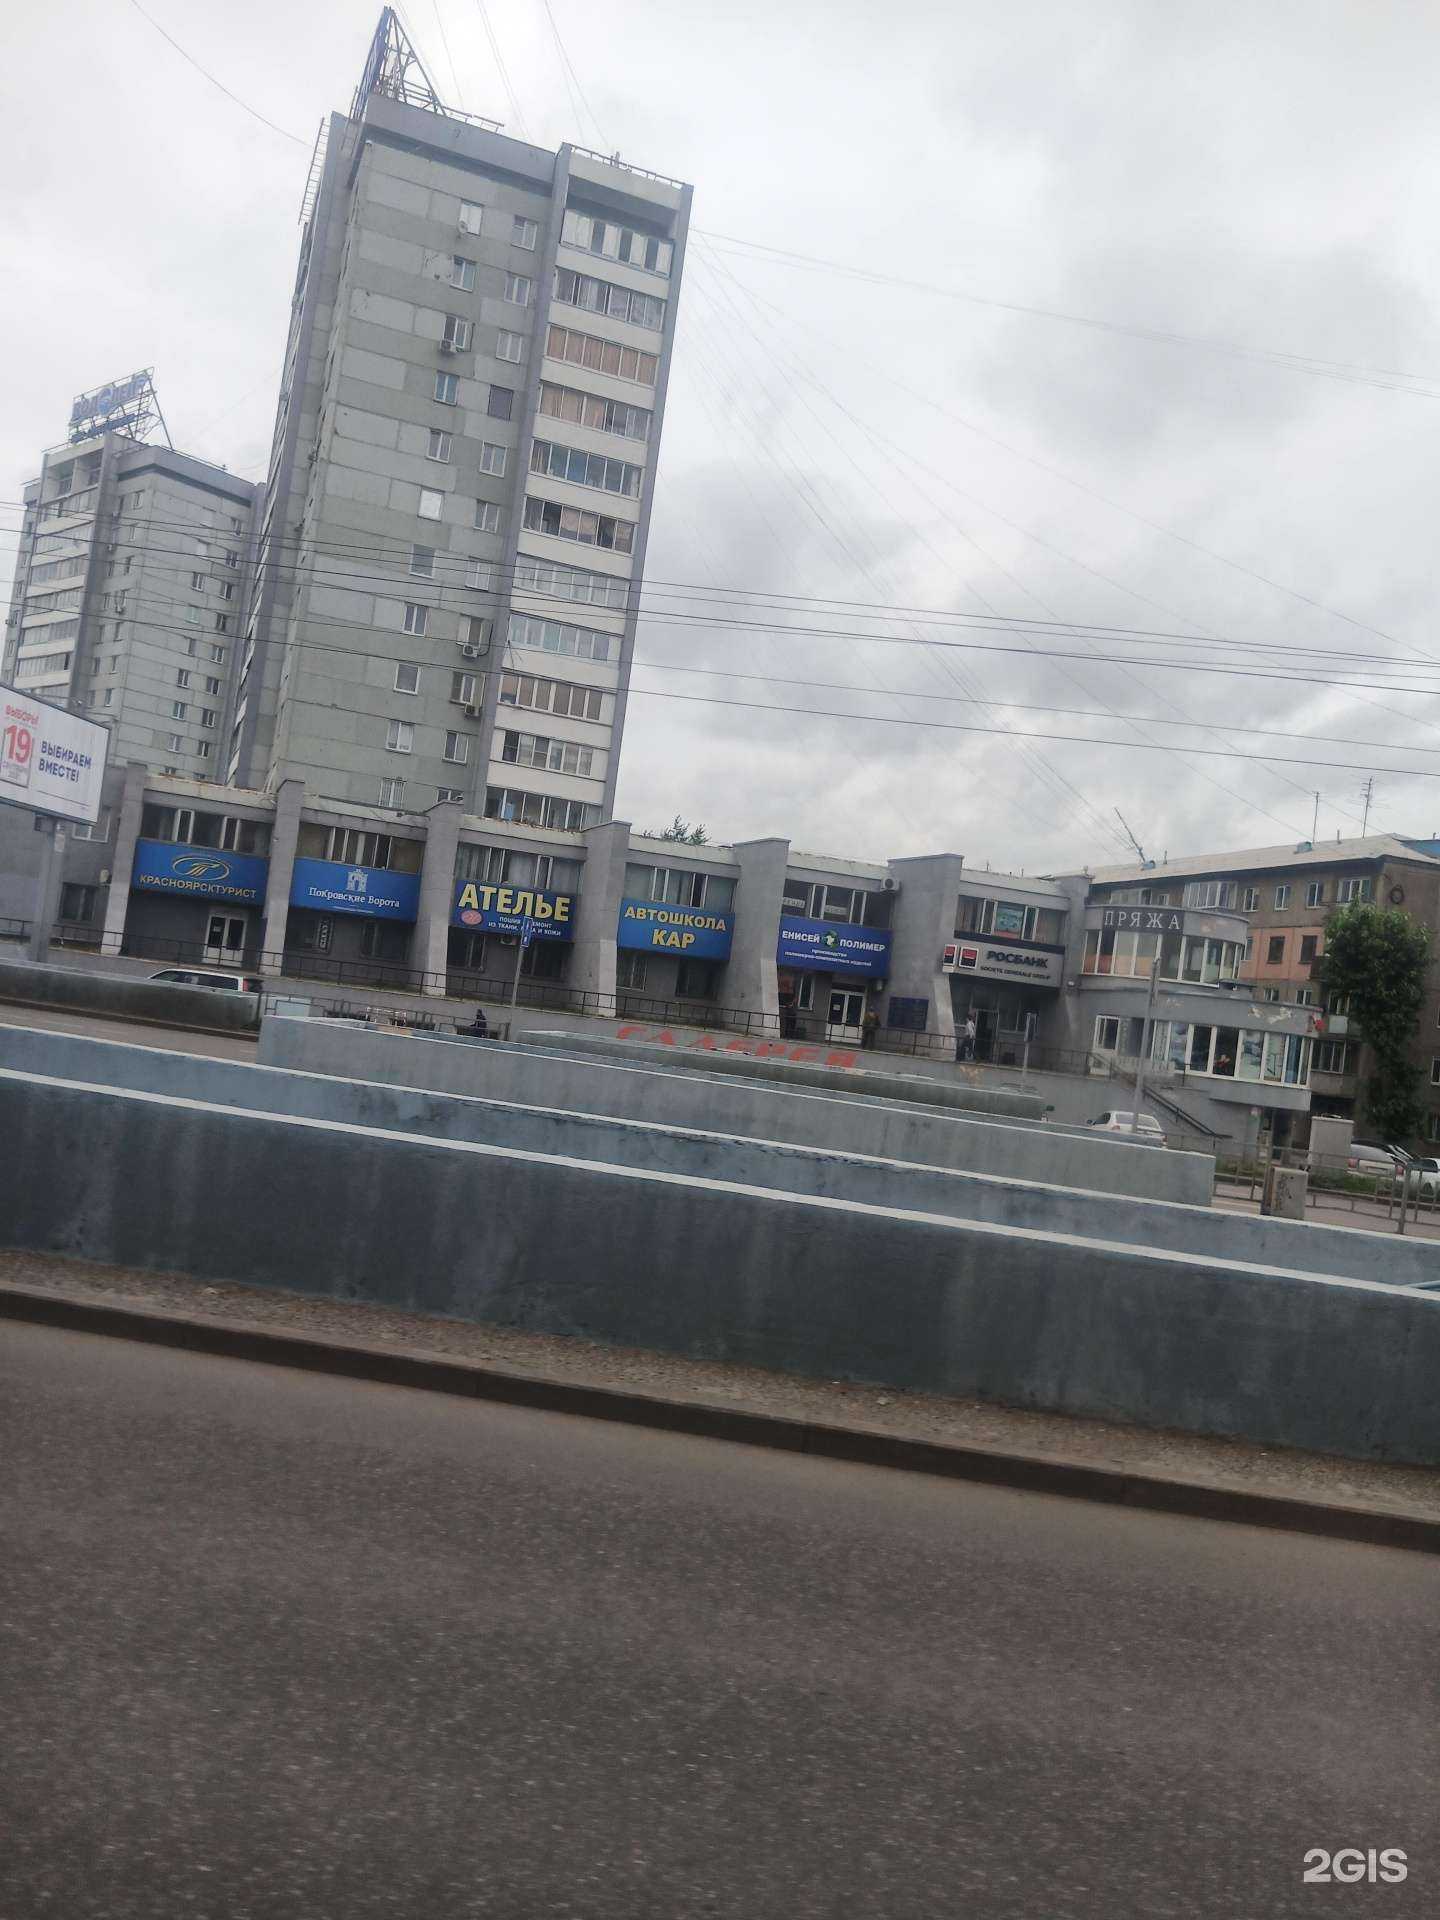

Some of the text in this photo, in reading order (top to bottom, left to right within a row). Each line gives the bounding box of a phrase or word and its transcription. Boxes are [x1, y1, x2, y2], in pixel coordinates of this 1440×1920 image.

[6, 725, 31, 763] 19
[41, 741, 91, 768] ВЫБИРАЕМ
[39, 758, 80, 782] ВМЕСТЕ!
[140, 875, 256, 898] КРАСНОЯРСКТУРИСТ
[308, 887, 400, 908] Покровские Ворота
[458, 883, 570, 921] АТЕЛЬЕ
[625, 906, 726, 931] АВТОШКОЛА
[1104, 910, 1181, 930] ПРЯЖА
[652, 928, 696, 949] КАР
[782, 930, 886, 951] ЕНИСЕЙ ПОЛИМЕР
[987, 950, 1048, 968] РОСБАНК
